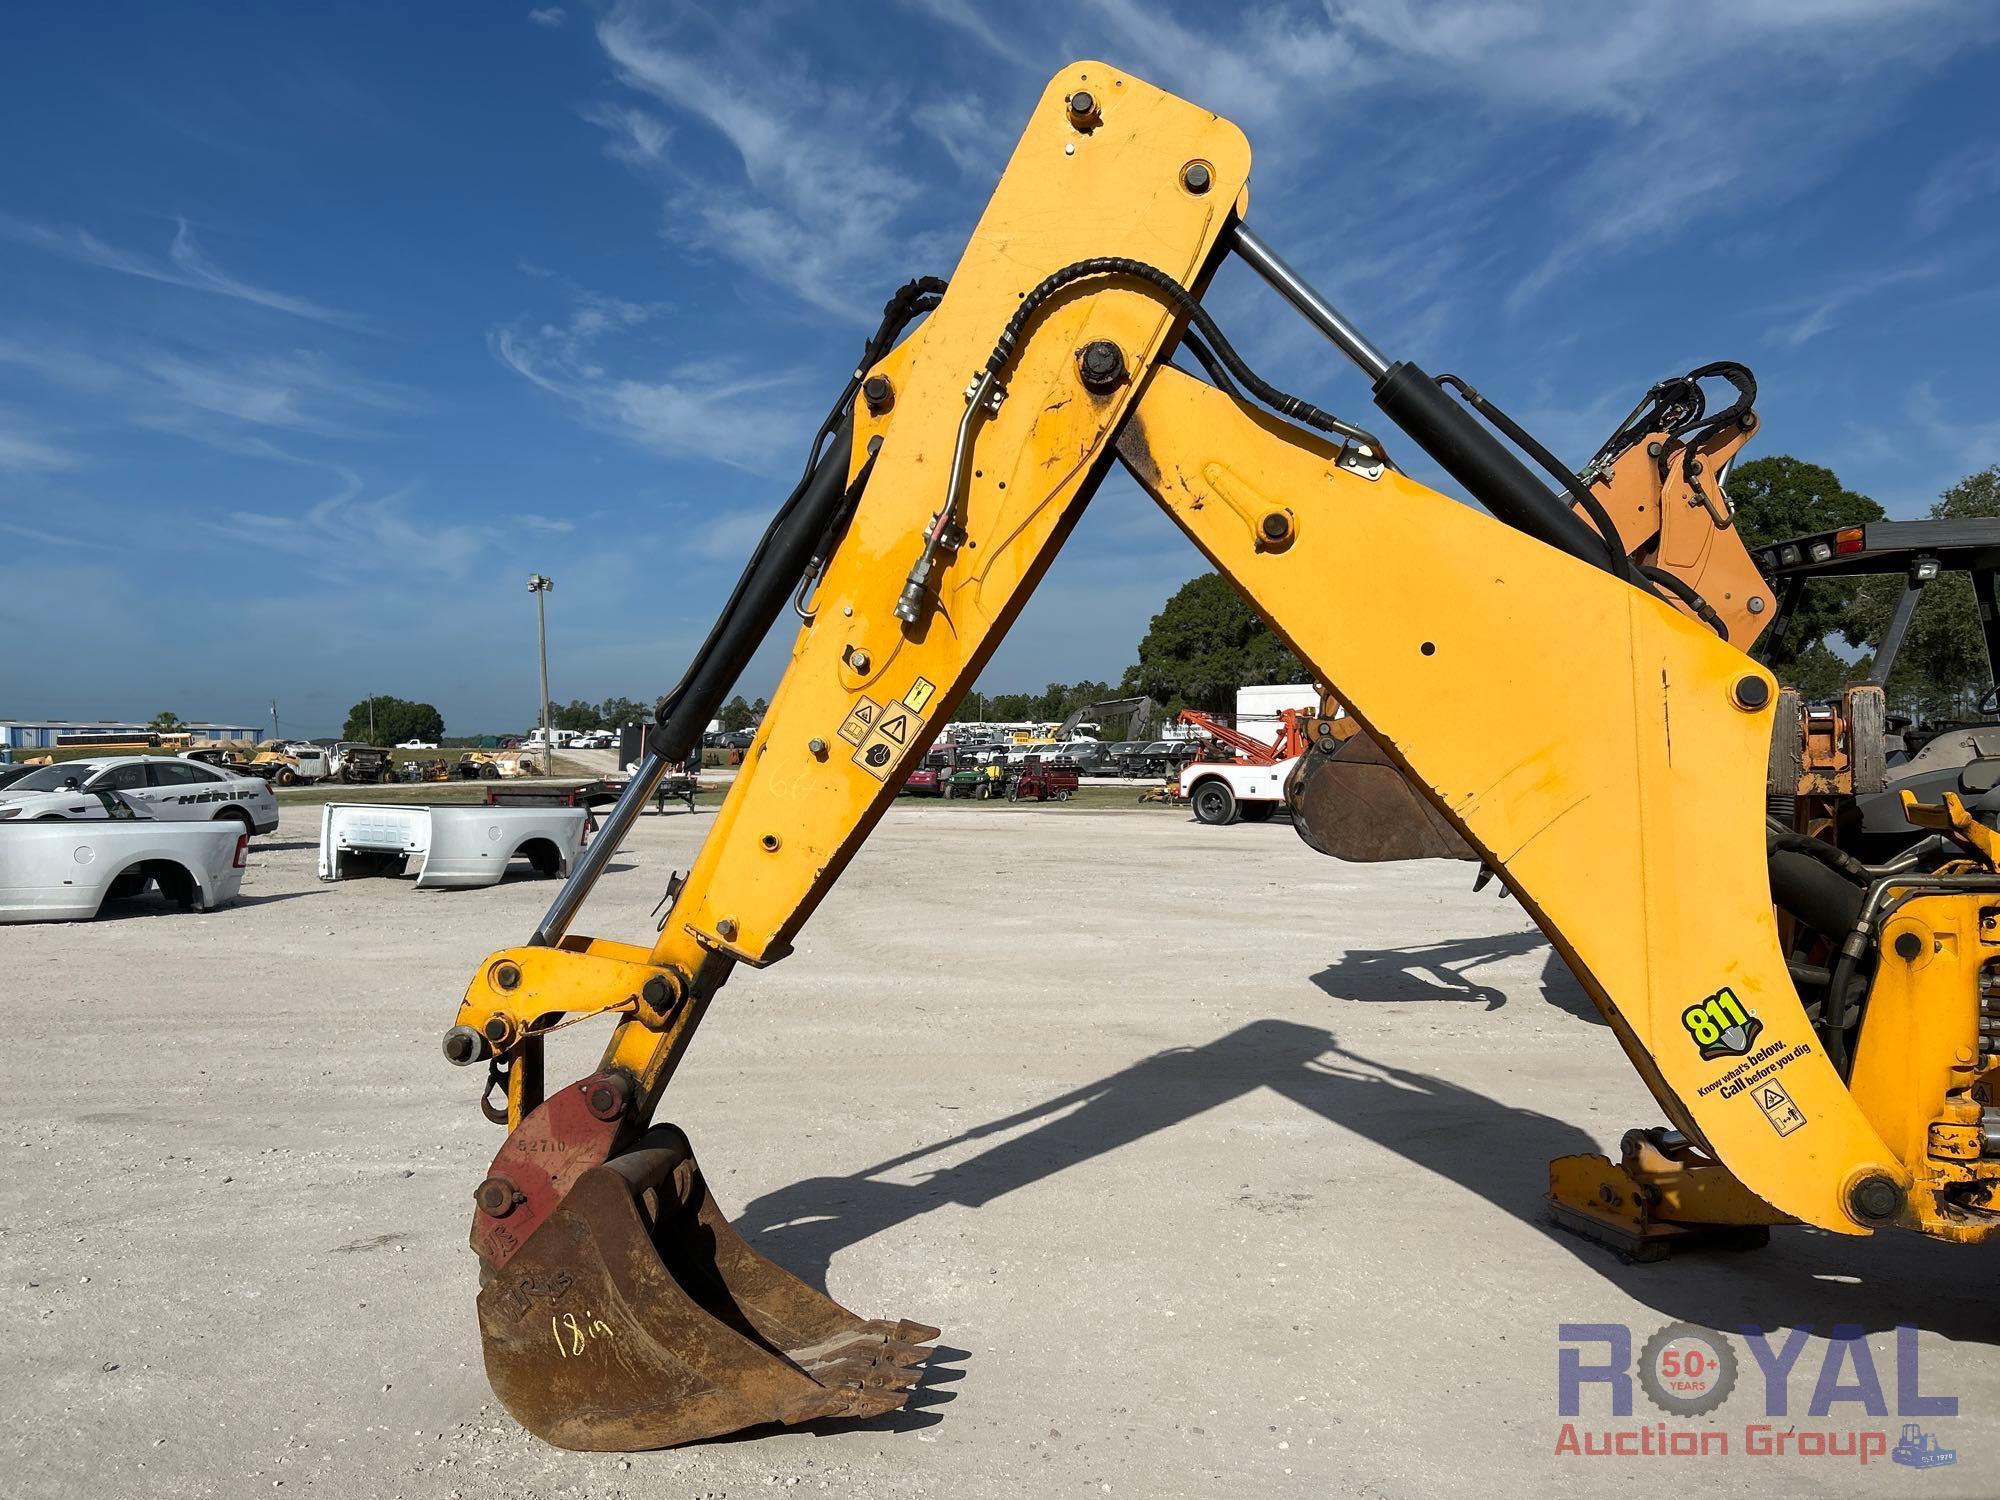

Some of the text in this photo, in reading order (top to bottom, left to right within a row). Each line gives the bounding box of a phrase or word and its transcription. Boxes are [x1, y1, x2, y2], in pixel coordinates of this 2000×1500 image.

[1686, 991, 1749, 1045] 811
[1697, 1040, 1787, 1097] Know what's below.
[1720, 1043, 1811, 1099] Call before you dig
[518, 1140, 565, 1153] 52710
